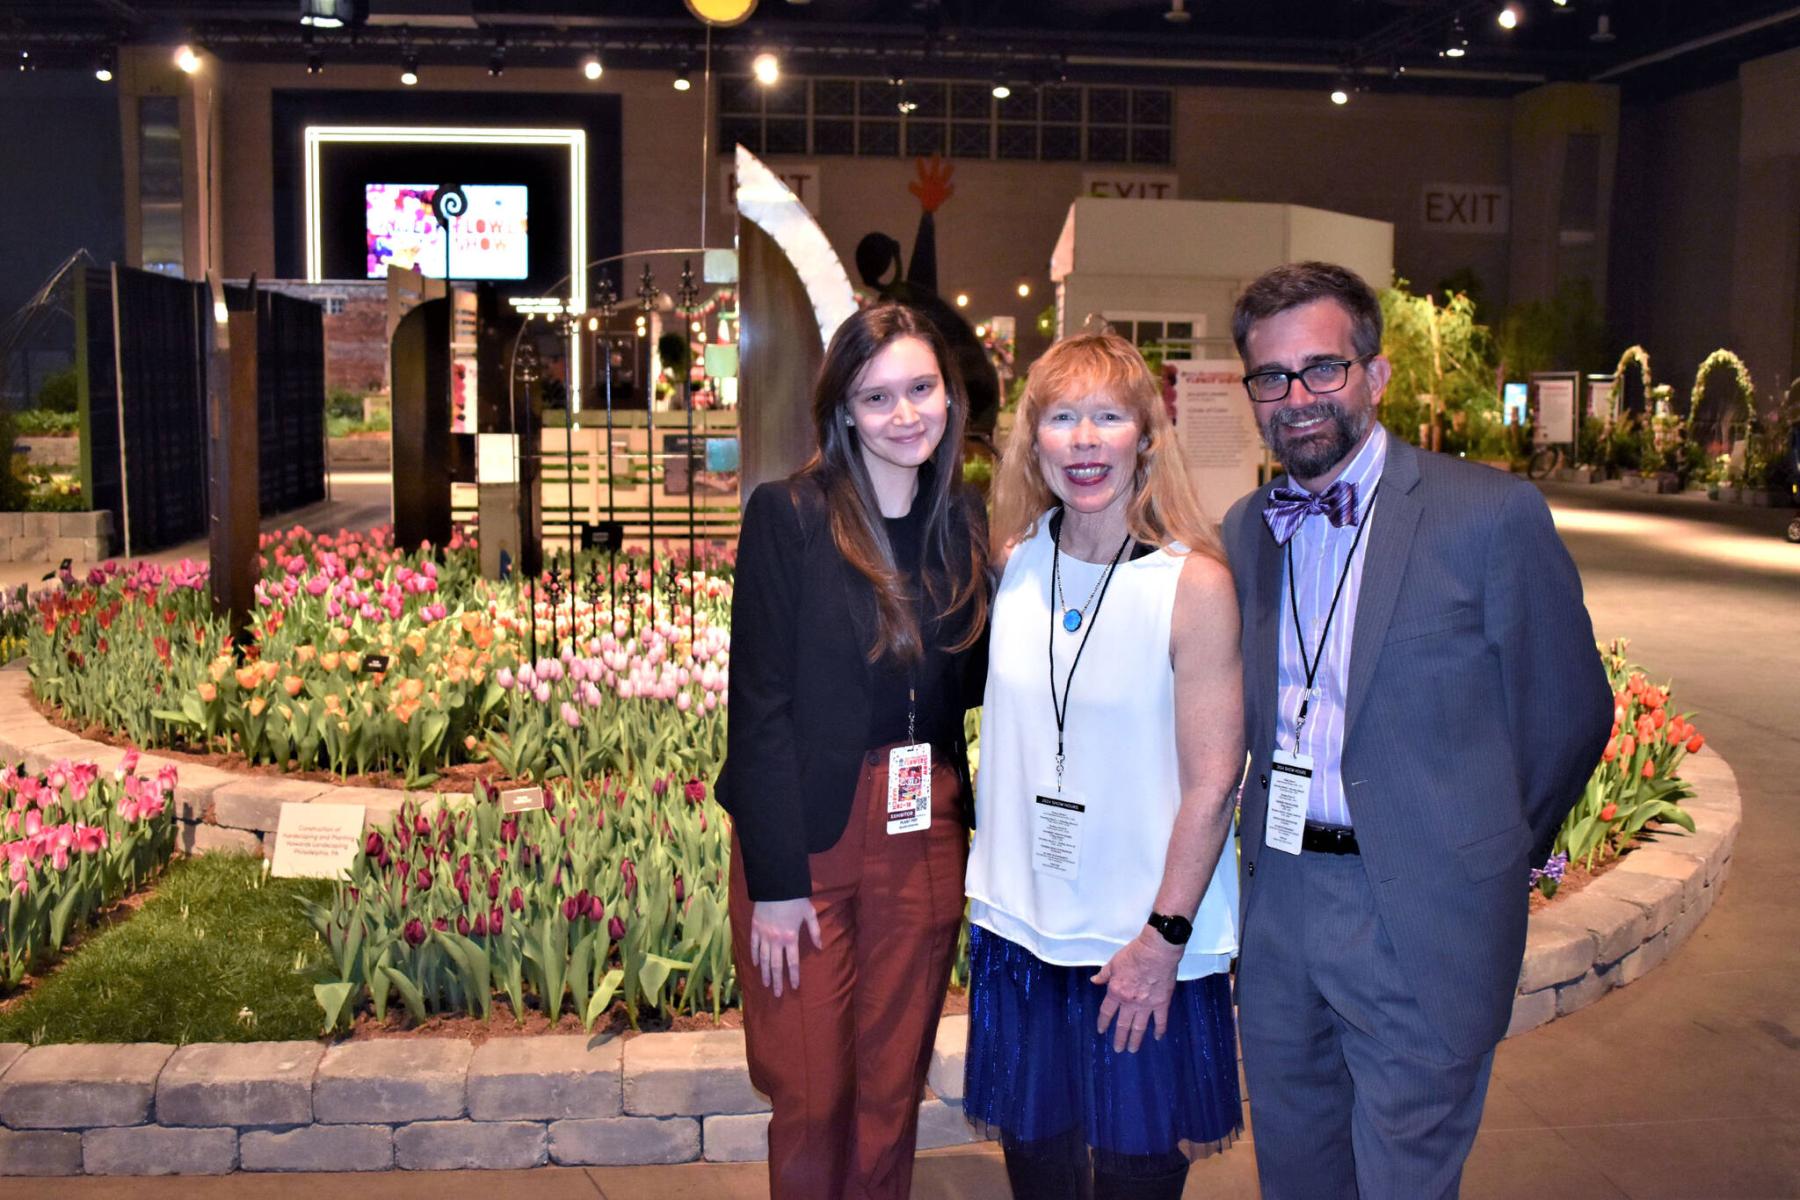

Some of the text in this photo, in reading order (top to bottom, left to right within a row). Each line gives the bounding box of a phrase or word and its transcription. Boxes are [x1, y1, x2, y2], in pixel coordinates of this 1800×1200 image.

[1425, 191, 1501, 224] EXIT
[1064, 802, 1080, 810] HOURS
[890, 810, 914, 819] EXHIBITOR
[298, 824, 333, 832] Construction
